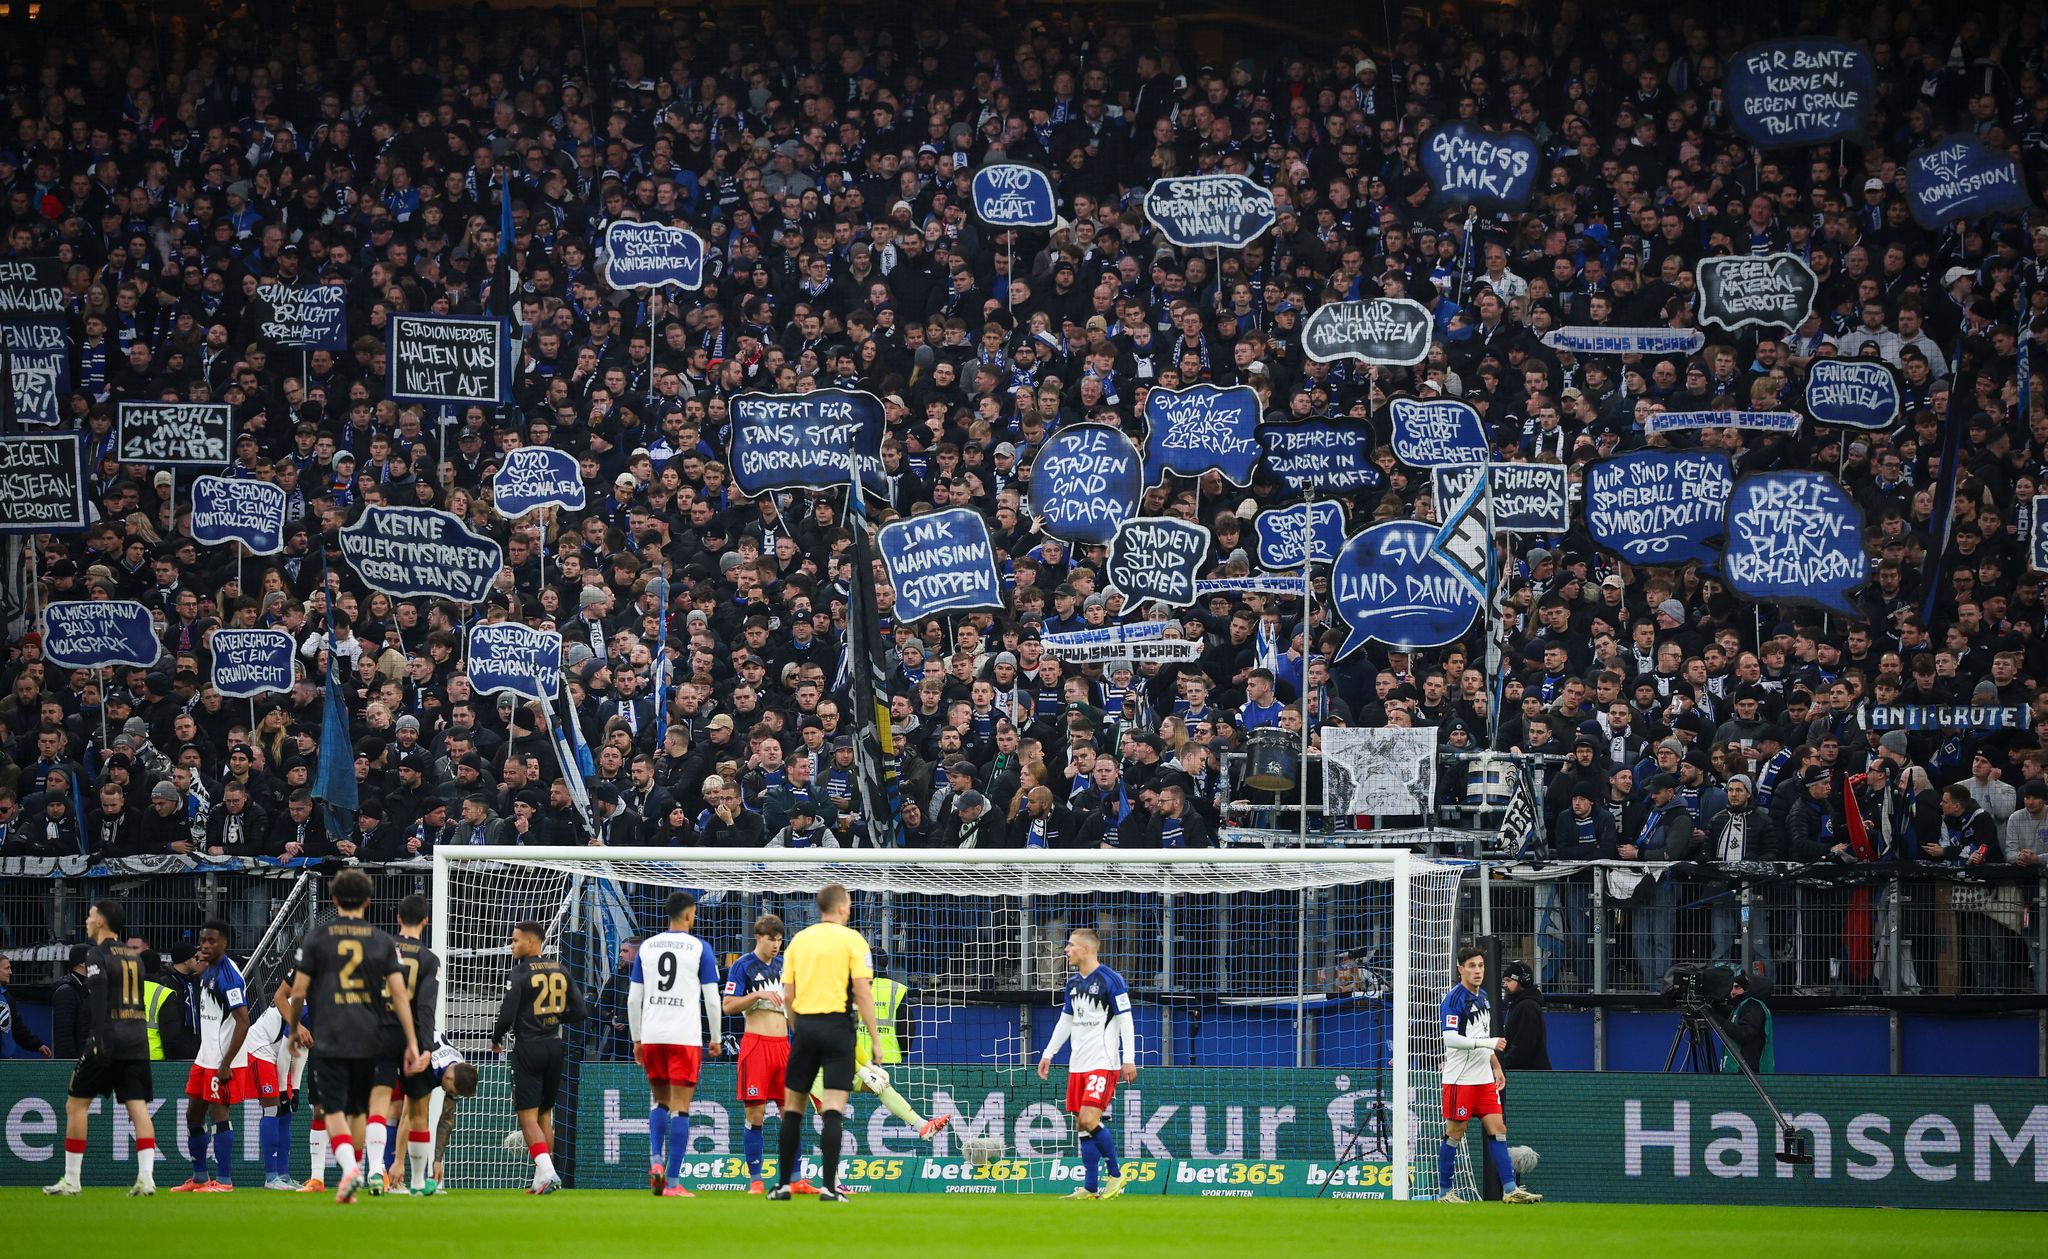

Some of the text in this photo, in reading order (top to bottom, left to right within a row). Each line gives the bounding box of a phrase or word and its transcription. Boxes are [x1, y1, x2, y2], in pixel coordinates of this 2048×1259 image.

[1746, 50, 1858, 75] FÜR BUNTE
[1744, 91, 1858, 115] GEGEN GRAUE
[1760, 112, 1841, 136] POLITIK!
[1432, 132, 1529, 177] SCHEISS
[1919, 143, 1970, 171] KEINE
[986, 169, 1031, 189] PYRO
[1169, 179, 1243, 198] SCHEISS
[1919, 163, 2017, 205] KOMMISSION!
[983, 199, 1036, 220] GEWALT
[611, 229, 686, 249] FANKULTUR
[625, 243, 670, 257] STATT
[613, 255, 698, 273] KUNDENDATEN
[256, 284, 344, 305] FANKULTUR
[1722, 294, 1798, 313] VERBOTE
[272, 303, 340, 323] BRAUCHT
[1328, 302, 1395, 325] WILLKÜR
[0, 325, 65, 349] ENIGER
[401, 321, 495, 344] STADIONVERBOTE
[1313, 321, 1424, 345] ABSCHAFFEN
[400, 341, 496, 368] HALTEN UNS
[406, 366, 488, 396] NICHT AUF
[1816, 365, 1890, 392] FANKULTUR
[1155, 393, 1223, 410] SV HAT
[1811, 385, 1893, 411] ERHALTEN
[124, 409, 158, 428] ICH
[738, 401, 853, 421] RESPEKT FÜR
[1167, 408, 1241, 424] NOCH NIE
[1395, 403, 1464, 423] FREIHEIT
[152, 422, 207, 440] MICH
[1168, 421, 1232, 437] ETWAS
[1405, 420, 1462, 439] STIRBT
[124, 436, 225, 460] SICHER
[1060, 430, 1109, 453] DIE
[1398, 440, 1488, 463] SICHERHEIT
[0, 443, 60, 467] GEGEN
[514, 452, 549, 470] PYRO
[1044, 454, 1128, 479] STADIEN
[1336, 454, 1354, 467] IN
[507, 466, 559, 481] STATT
[1328, 470, 1380, 487] KAFF!
[1593, 456, 1723, 491] WIR SIND KEIN
[200, 482, 226, 497] DAS
[230, 483, 283, 508] STADION
[495, 479, 583, 499] PERSONALIEN
[1593, 478, 1732, 511] SPIELBALL EURER
[5, 503, 72, 521] VERBOTE
[211, 499, 233, 513] IST
[236, 501, 282, 520] KEINE
[1267, 508, 1335, 533] STADEN
[1591, 499, 1725, 538] SYMBOLPOLITI
[195, 511, 276, 533] KONTROLLZONE
[373, 512, 446, 539] KEINE
[1734, 508, 1855, 539] STUFEN-
[1124, 525, 1200, 554] STADIEN
[1380, 530, 1435, 566] SV
[1750, 535, 1826, 559] PLAN
[341, 533, 497, 571] KOLLEKTIVSTRAFEN
[893, 541, 986, 575] WAHNSINN
[1123, 550, 1185, 570] SIND
[360, 558, 482, 599] GEGEN FANS!
[1727, 550, 1865, 587] VERHINDERN!
[902, 569, 990, 608] STOPPEN
[1114, 567, 1187, 596] SICHER
[1196, 579, 1255, 592] PULISMUS
[1340, 573, 1398, 603] UND
[59, 620, 124, 636] BALD IM
[50, 637, 138, 656] VOLKSPARK
[214, 635, 287, 653] DATENSCHUTZ
[491, 644, 540, 664] STATT
[228, 650, 275, 662] IST EIN
[217, 666, 284, 684] GRUNDRECHT
[337, 940, 365, 989] 2
[658, 951, 677, 992] 9
[121, 960, 139, 1006] 11
[531, 972, 567, 1016] 28
[210, 1077, 219, 1092] 6
[1086, 1074, 1106, 1093] 28
[604, 1089, 1297, 1164] HaseMekur
[1624, 1100, 2048, 1182] HanseM
[800, 1159, 903, 1180] bt365
[921, 1158, 1029, 1181] bet365
[1050, 1159, 1157, 1182] be65
[1177, 1161, 1285, 1184] bet365
[1307, 1163, 1415, 1187] bet36
[696, 1183, 746, 1192] SPORTWETTEN
[945, 1184, 997, 1194] SPORTWETTEN
[1202, 1189, 1254, 1199] SPORTWETTEN
[1332, 1191, 1384, 1200] SPORTWETTEN
